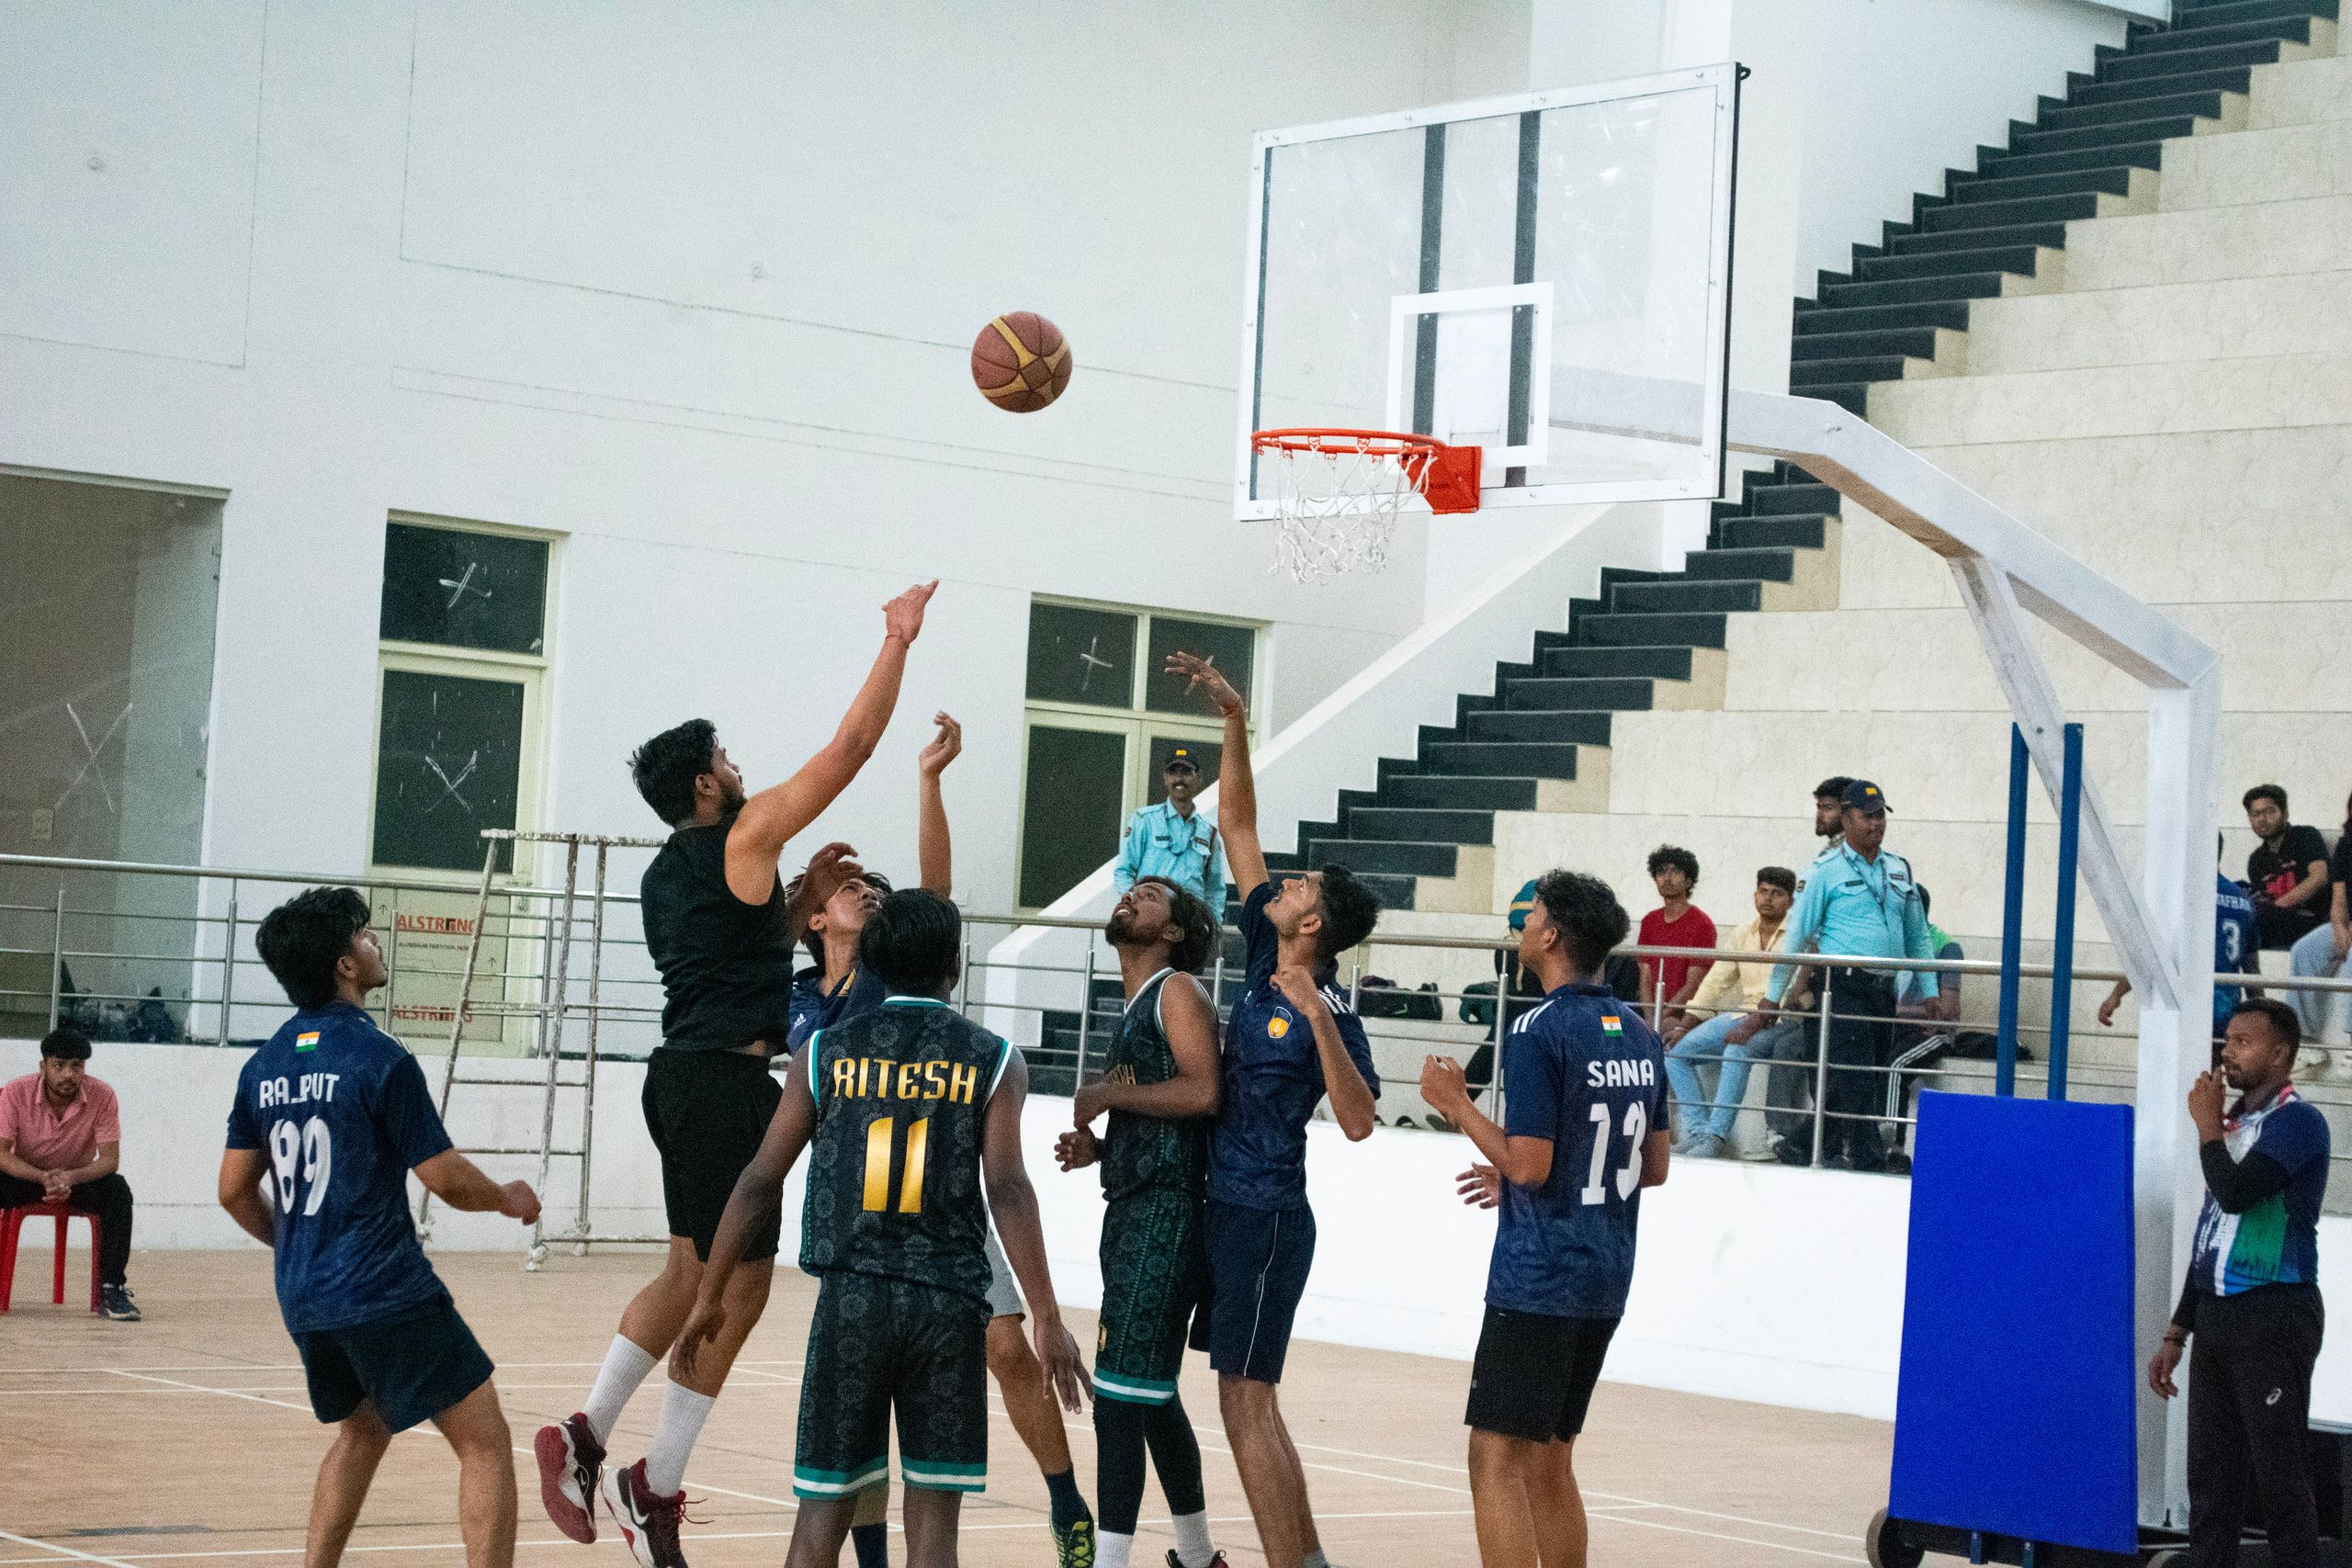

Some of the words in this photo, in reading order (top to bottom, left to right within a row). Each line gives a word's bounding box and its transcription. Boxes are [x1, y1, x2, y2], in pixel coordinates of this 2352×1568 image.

[833, 1057, 978, 1104] RITESH
[1587, 1059, 1655, 1088] SANA
[269, 1114, 332, 1216] 89
[862, 1117, 929, 1213] 11
[1581, 1100, 1647, 1206] 13
